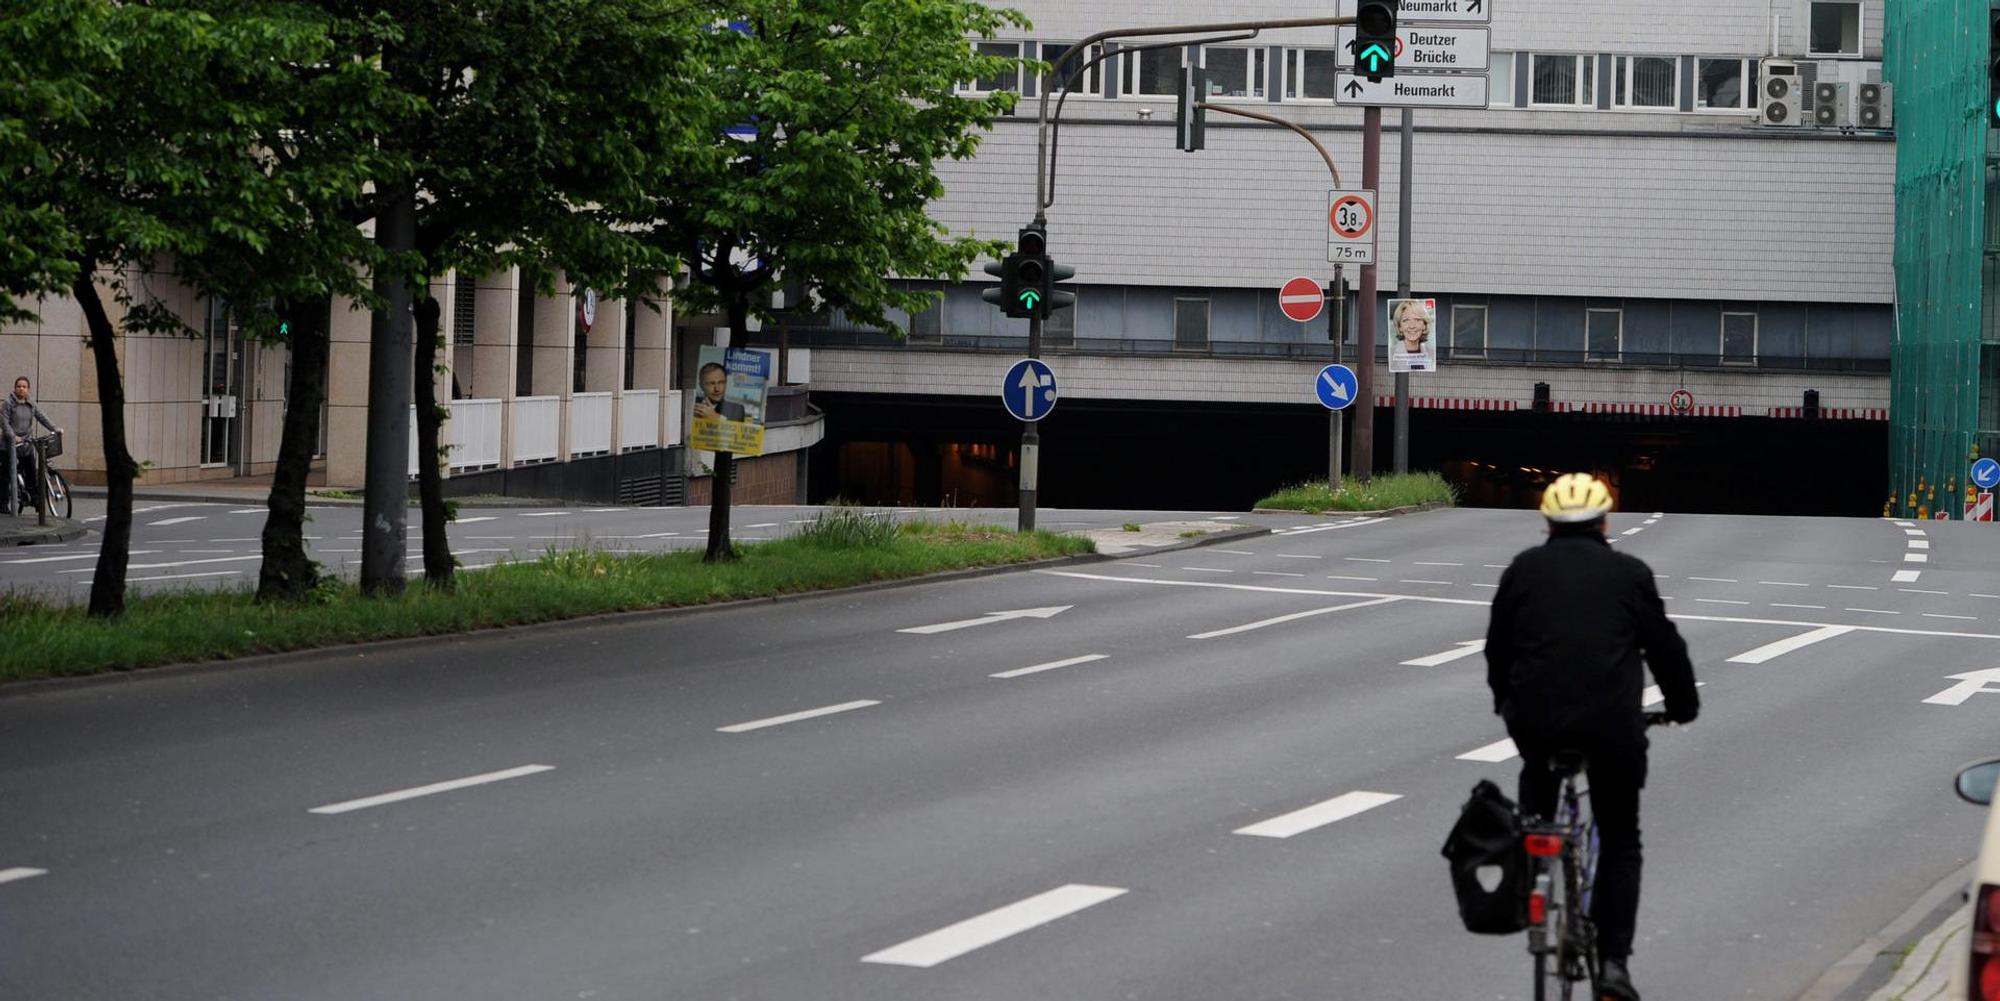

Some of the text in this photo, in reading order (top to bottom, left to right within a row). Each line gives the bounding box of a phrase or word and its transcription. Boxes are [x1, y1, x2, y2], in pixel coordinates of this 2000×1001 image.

[1398, 0, 1457, 12] Neumarkt
[1409, 32, 1457, 46] Deutzer
[1413, 50, 1457, 63] Brücke
[1394, 83, 1455, 97] Heumarkt
[1336, 247, 1366, 258] 75 m
[727, 350, 761, 362] Lindner
[725, 362, 761, 374] kommt!
